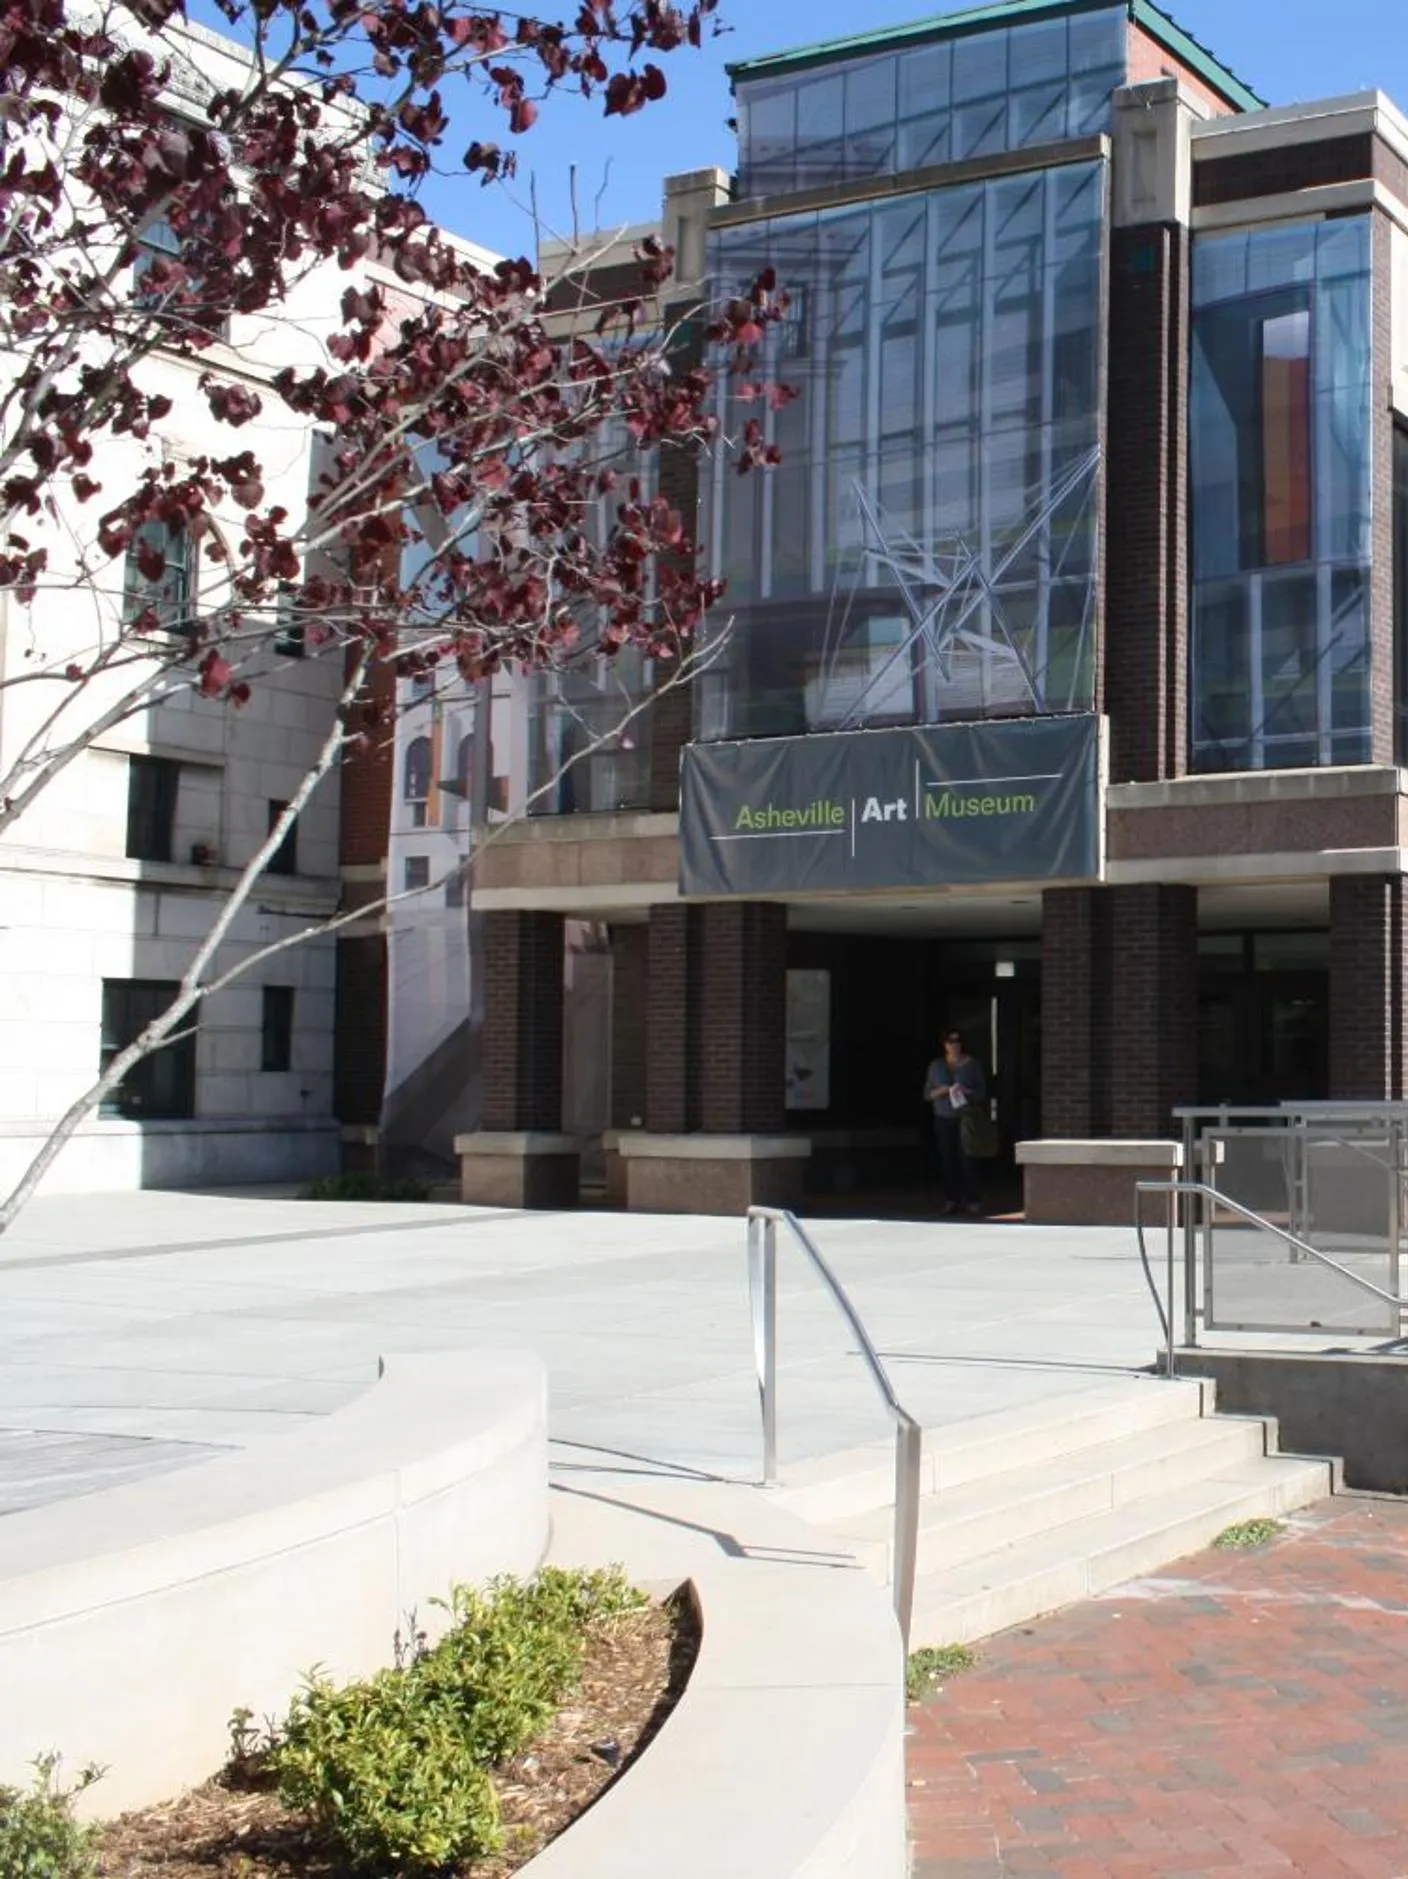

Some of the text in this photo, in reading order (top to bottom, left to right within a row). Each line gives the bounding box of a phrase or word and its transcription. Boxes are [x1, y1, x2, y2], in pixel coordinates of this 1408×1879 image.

[735, 793, 1034, 830] Asheville Art Museum
